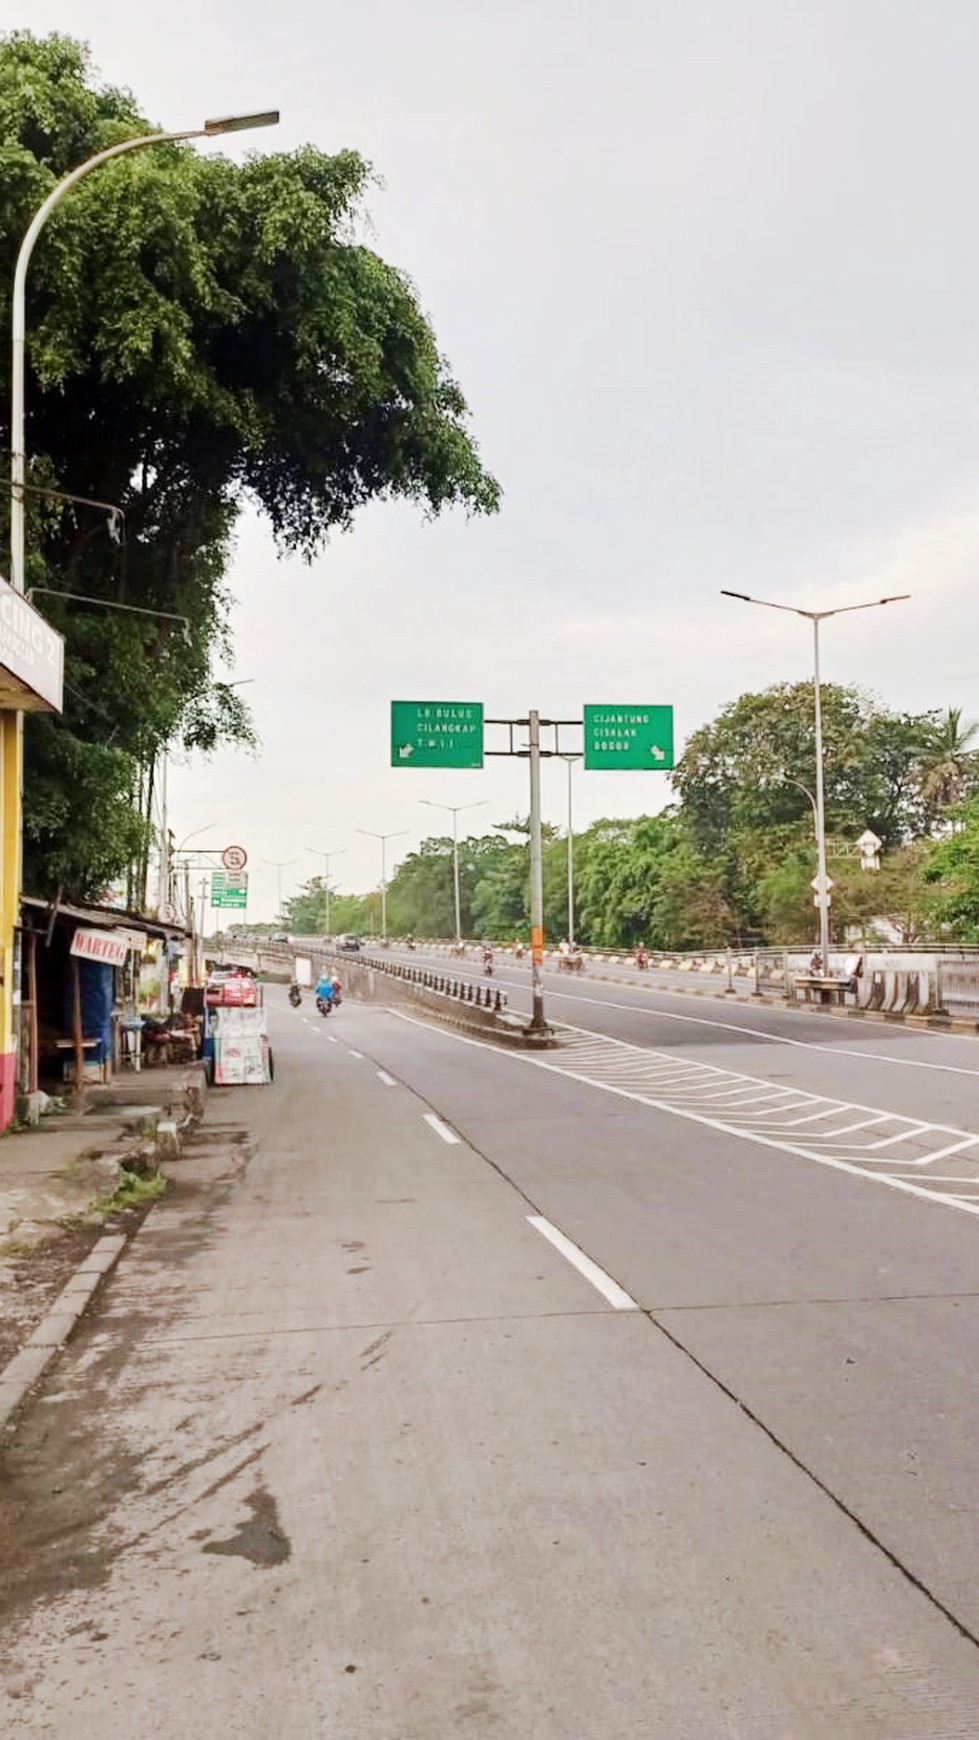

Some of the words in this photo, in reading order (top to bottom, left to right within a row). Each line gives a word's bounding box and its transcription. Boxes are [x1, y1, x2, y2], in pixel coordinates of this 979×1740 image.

[46, 636, 56, 667] 2
[436, 708, 472, 718] BULUS
[593, 714, 650, 724] CIJANTUNG
[417, 723, 477, 733] CILANGKAP
[593, 728, 637, 737] CISALAK
[594, 741, 630, 751] BOGOR
[74, 931, 124, 961] WARTEG
